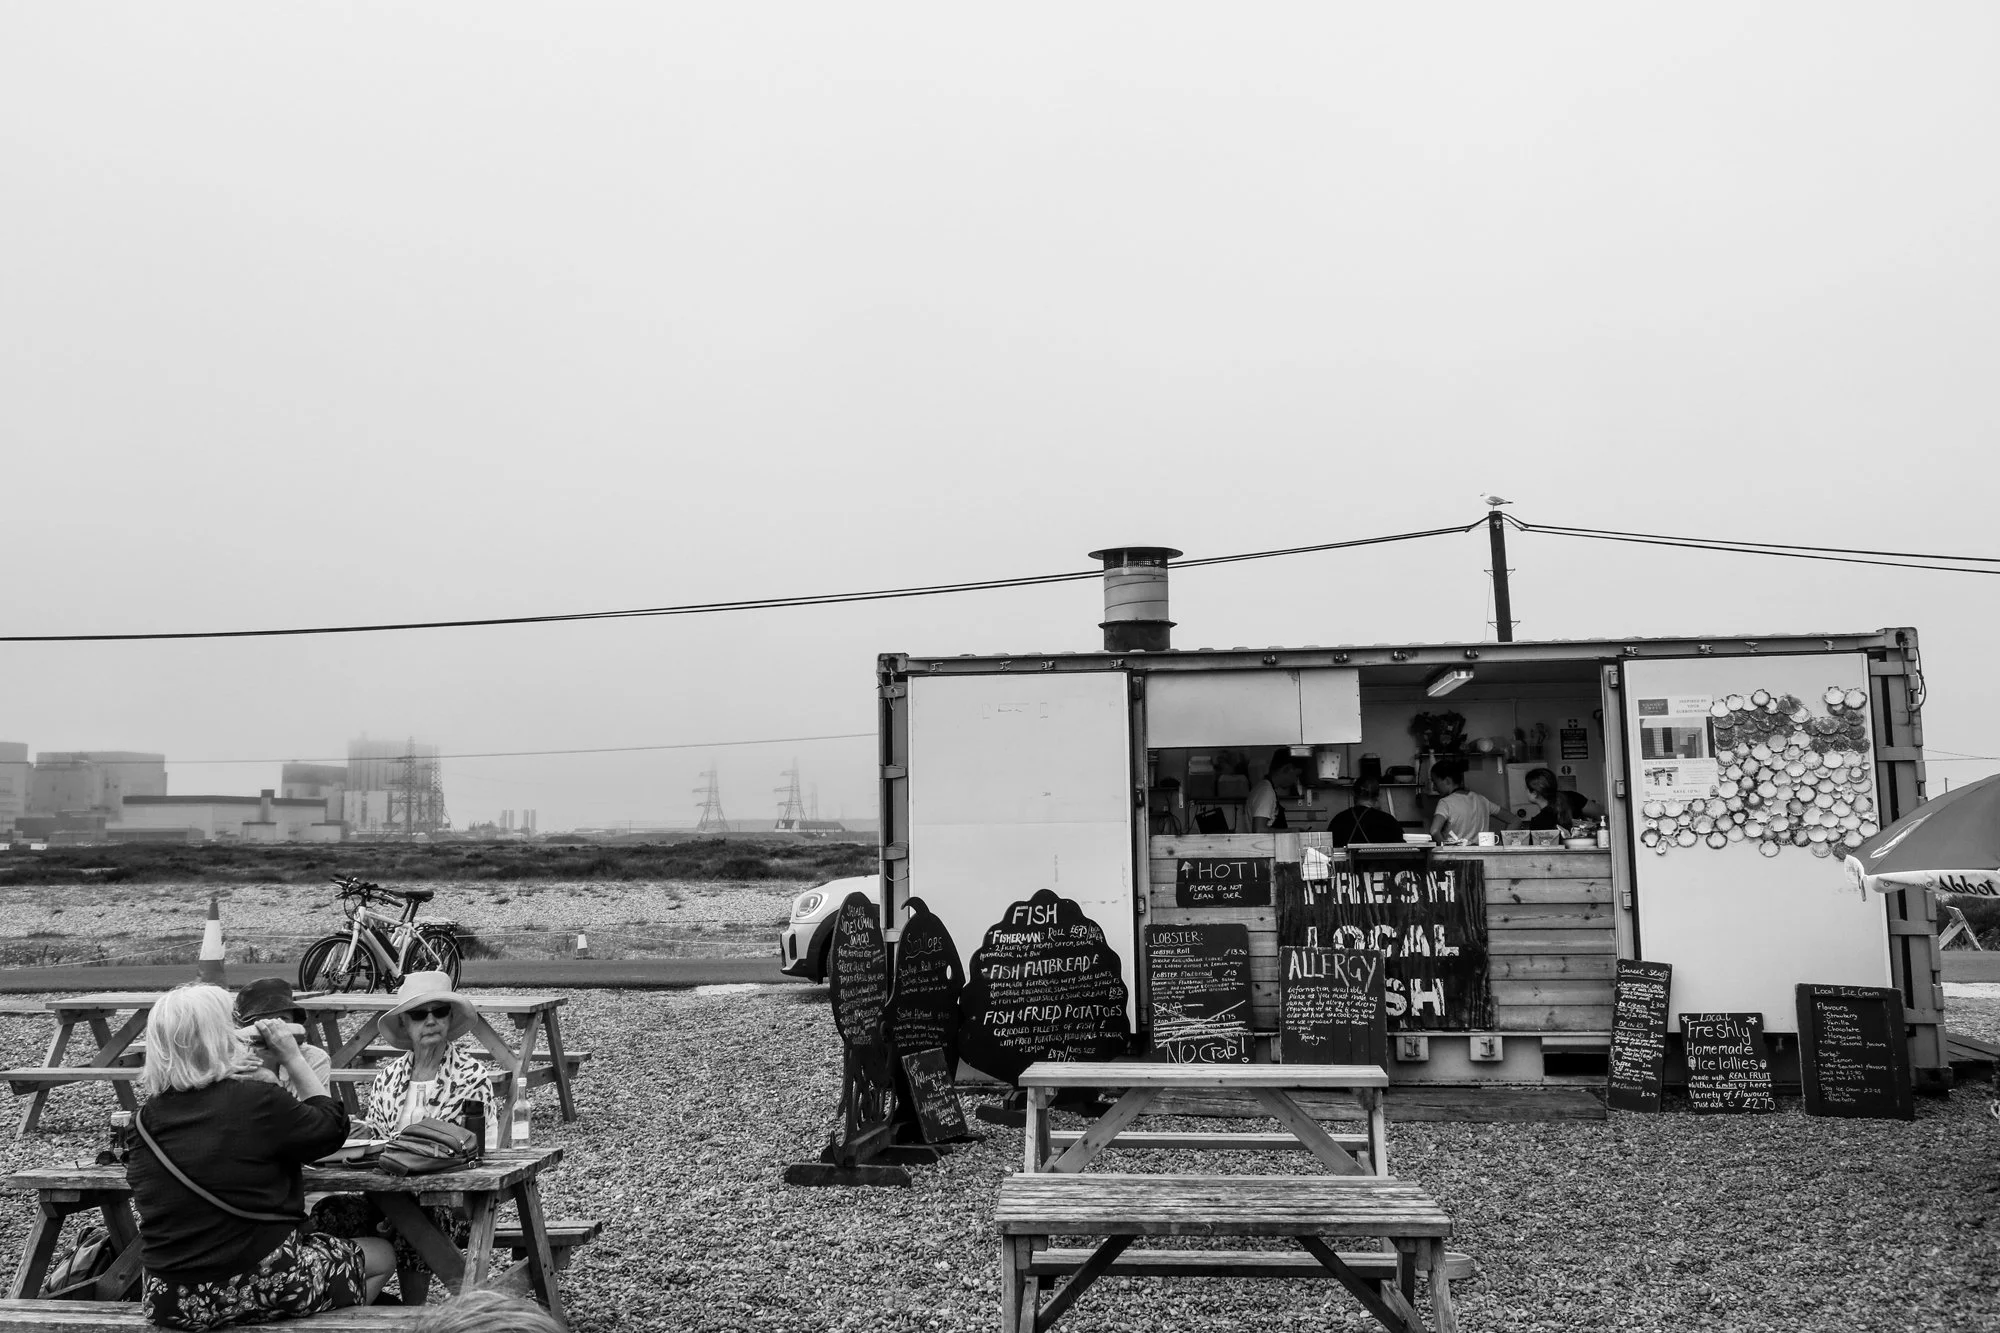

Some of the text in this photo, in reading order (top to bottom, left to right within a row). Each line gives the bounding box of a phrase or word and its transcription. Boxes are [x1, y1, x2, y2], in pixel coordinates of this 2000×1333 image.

[1190, 884, 1214, 892] PLEASE
[1304, 870, 1455, 905] FRESH
[1193, 891, 1242, 900] LEAN OVER
[1012, 903, 1057, 925] FISH
[1152, 931, 1203, 944] LOBSTER:
[1307, 924, 1459, 957] LOCAL
[1176, 947, 1190, 955] Roll
[990, 954, 1099, 980] FISH FLATBREAD £
[1289, 950, 1377, 992] ALLERGY
[1618, 965, 1645, 975] Sweet
[1386, 978, 1446, 1016] SH
[1814, 986, 1880, 997] Local Ice Cream
[1816, 1001, 1849, 1011] Flavours
[984, 1004, 1122, 1025] FISH FRIED POTATOES
[1700, 1013, 1732, 1022] Local
[1826, 1012, 1858, 1021] Strawberry
[993, 1026, 1029, 1037] GRIDDLED
[1032, 1024, 1060, 1033] FILLETS
[1076, 1022, 1095, 1030] FISH
[1688, 1020, 1751, 1045] Freshly
[1827, 1025, 1861, 1033] Chocolate
[1015, 1037, 1031, 1045] FRIED
[1828, 1032, 1862, 1041] Honeycomb
[1024, 1045, 1045, 1053] LEMON
[1166, 1041, 1197, 1064] NO
[1199, 1036, 1249, 1063] Crab!
[1686, 1041, 1754, 1056] Homemade
[1698, 1056, 1759, 1070] Ice lollies
[1729, 1071, 1748, 1079] REAL
[1749, 1071, 1771, 1079] FRUIT
[1738, 1082, 1747, 1090] of
[1689, 1089, 1721, 1103] Variety
[1723, 1090, 1733, 1100] of
[1742, 1097, 1776, 1110] £2.75
